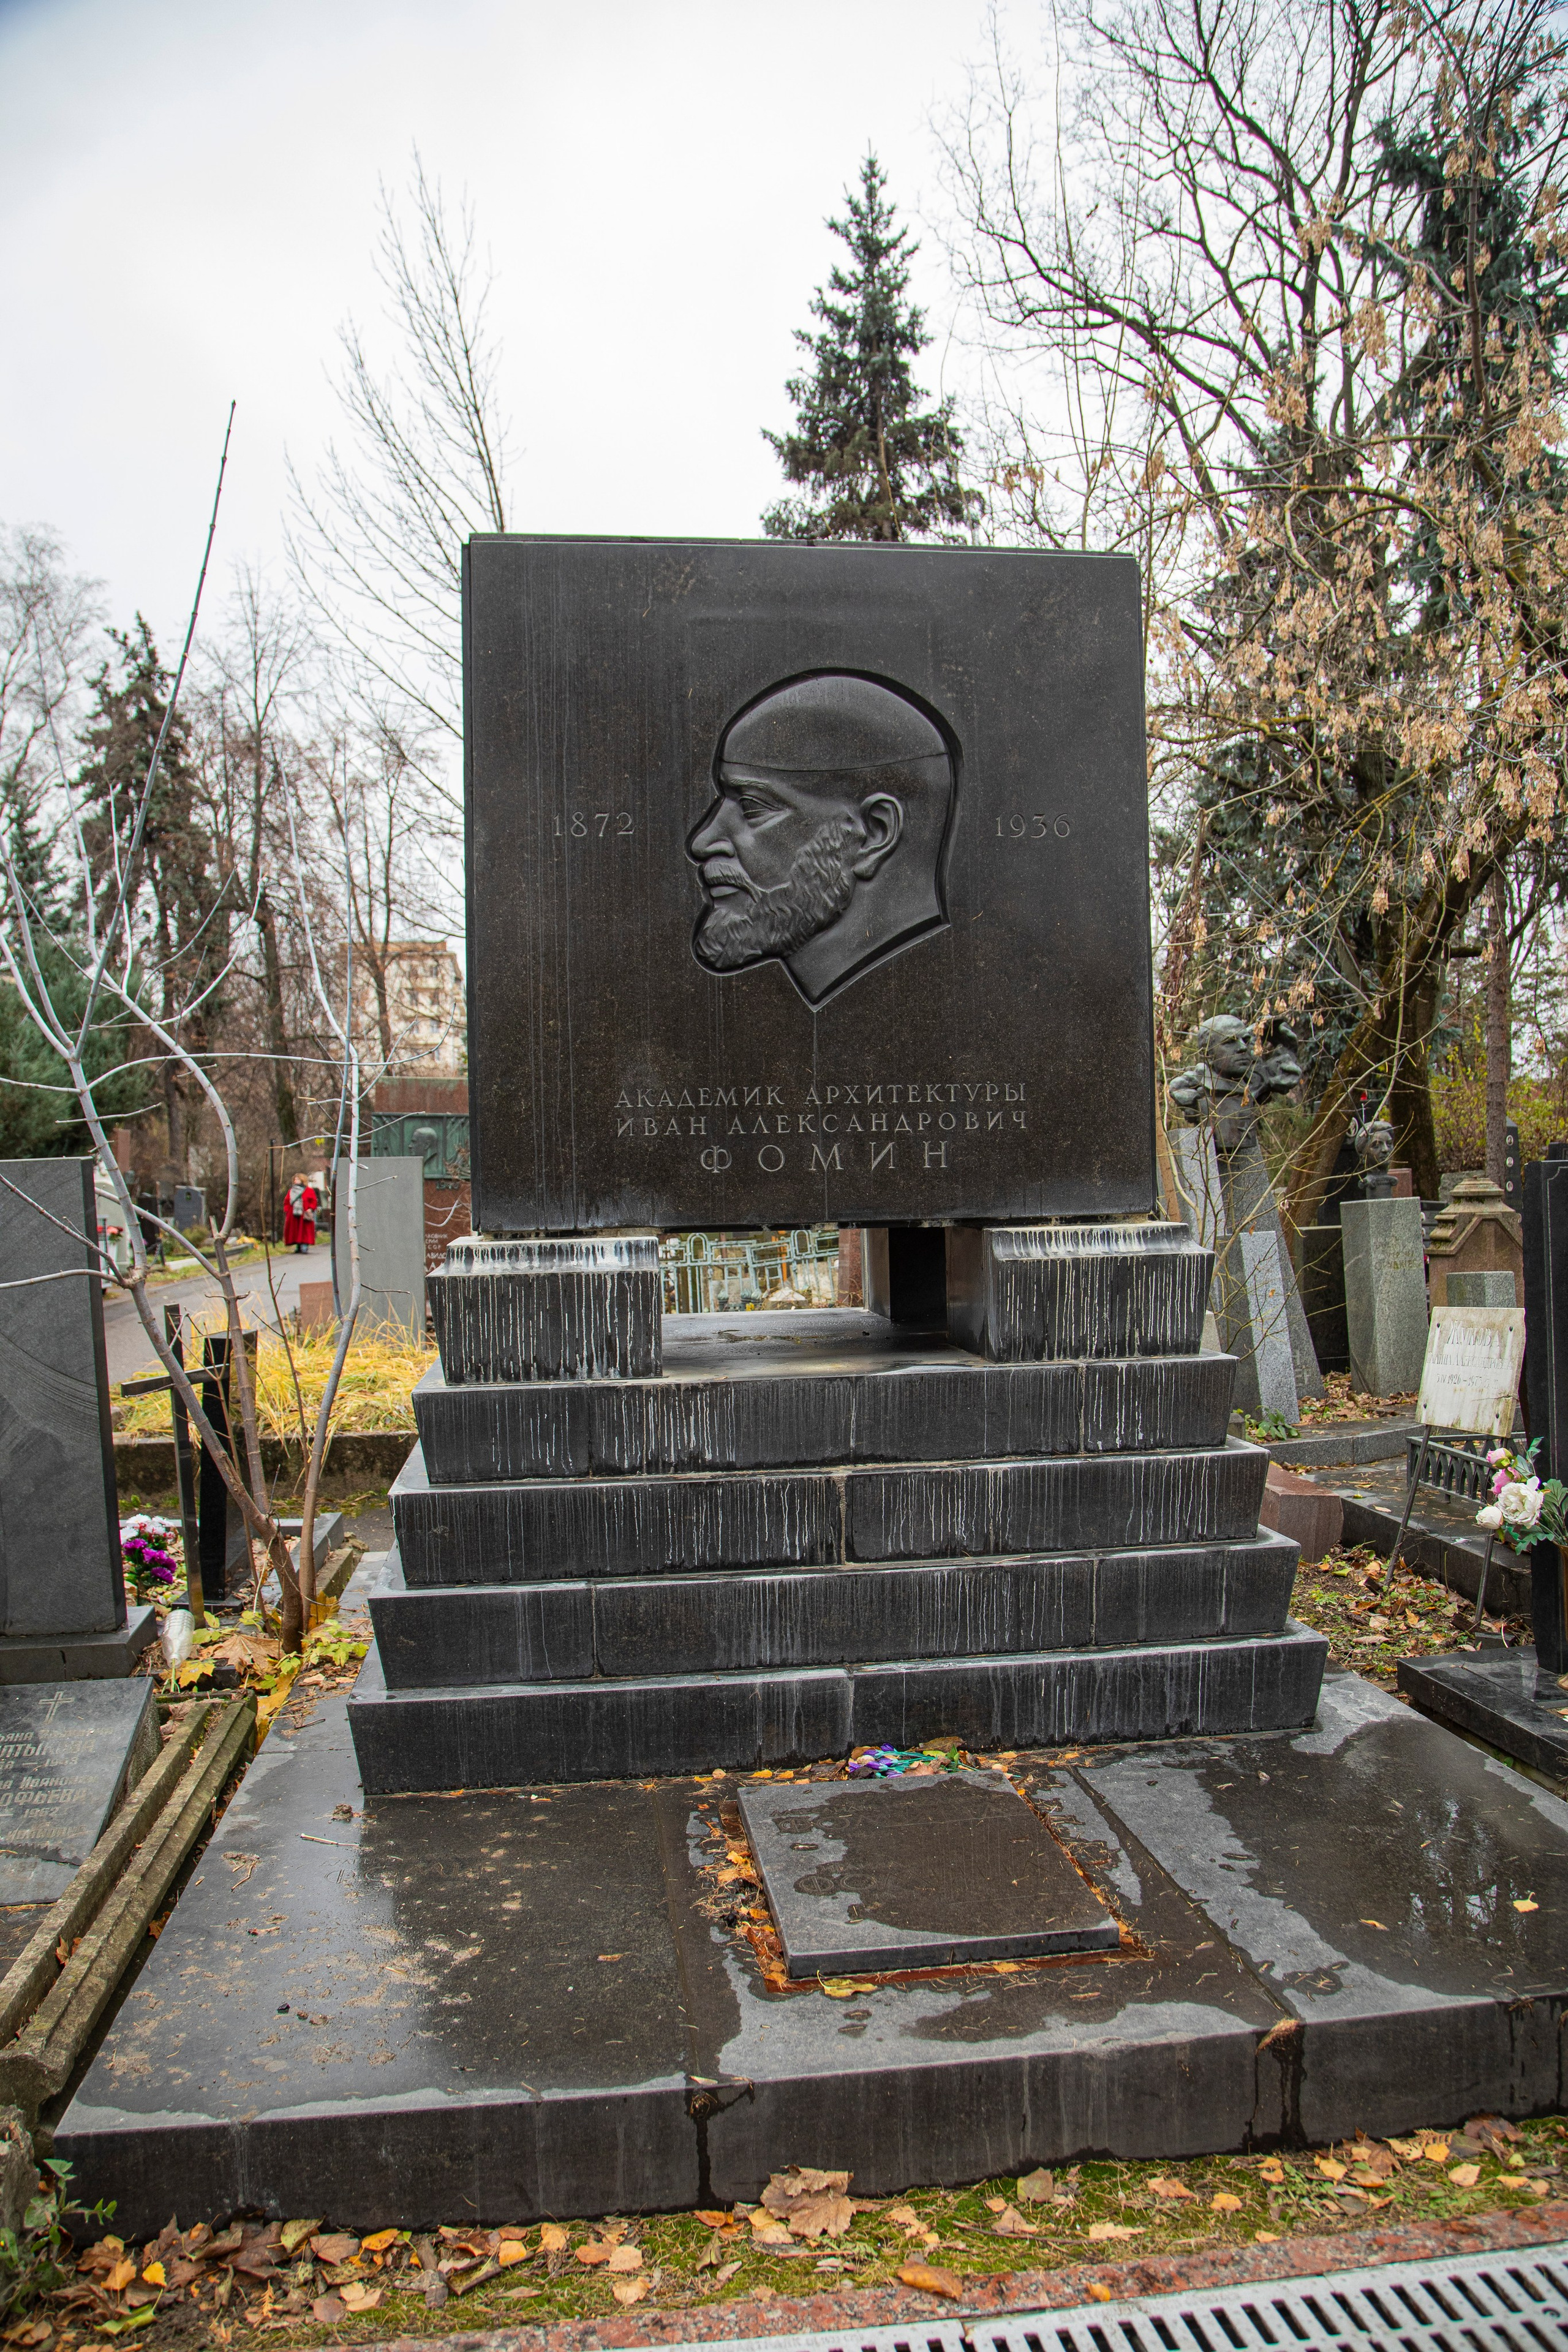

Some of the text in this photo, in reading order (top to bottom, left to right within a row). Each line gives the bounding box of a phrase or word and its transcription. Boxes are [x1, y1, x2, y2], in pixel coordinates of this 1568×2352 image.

[553, 812, 636, 837] 1872
[995, 813, 1071, 838] 1936
[614, 1081, 1026, 1109] АКАДЕМИК АРХИТЕКТУРЫ
[616, 1110, 1026, 1137] ИВАН АЛЕКСАНДРОВИЧ
[699, 1140, 948, 1174] ФОМИН
[1447, 1320, 1500, 1348] ЖУКОВА
[1447, 1373, 1461, 1384] 1926
